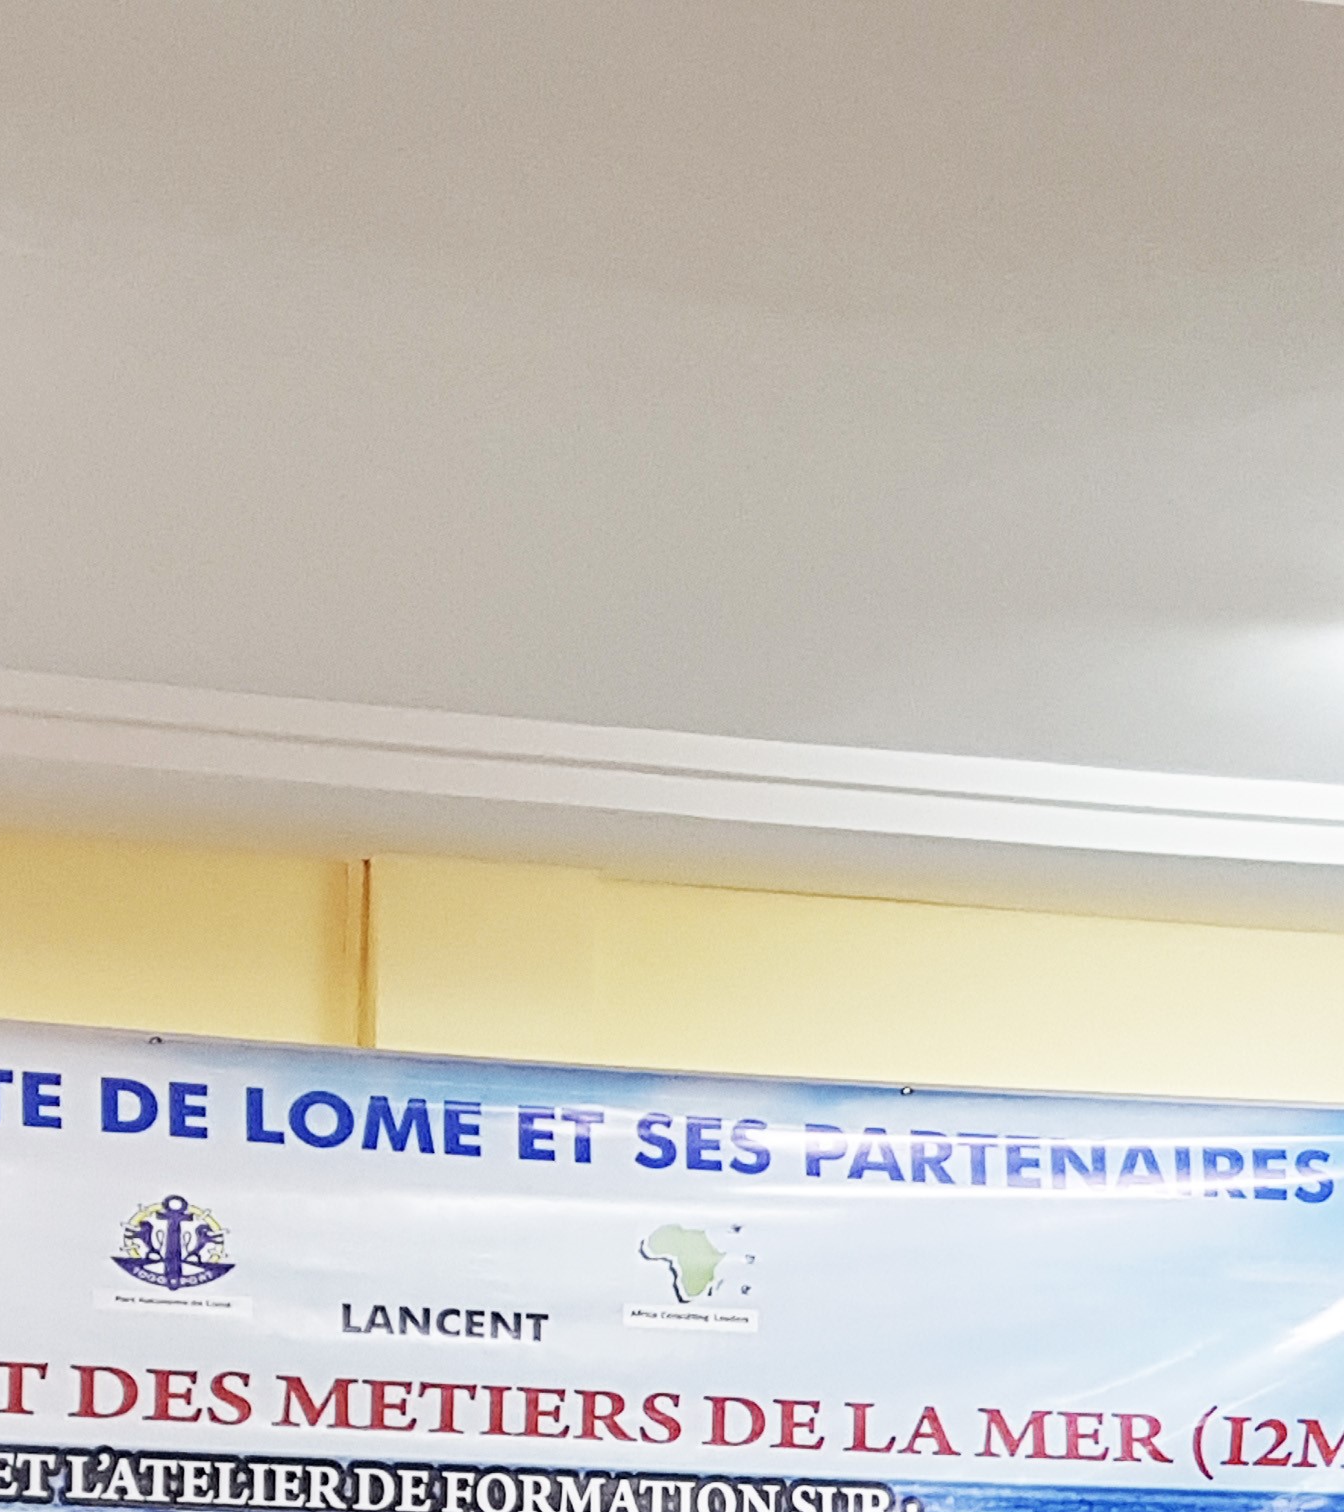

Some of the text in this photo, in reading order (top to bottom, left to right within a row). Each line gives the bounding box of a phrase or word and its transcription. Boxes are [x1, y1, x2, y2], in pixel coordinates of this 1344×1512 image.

[100, 1076, 208, 1140] DE
[246, 1086, 482, 1158] LOME
[518, 1104, 605, 1166] ET
[634, 1111, 772, 1175] SES
[804, 1122, 1335, 1204] PARTENAIRES
[341, 1302, 549, 1343] LANCENT
[69, 1364, 253, 1426] DES
[273, 1374, 682, 1448] METIERS
[702, 1396, 825, 1452] DE
[844, 1401, 962, 1457] LA
[974, 1408, 1172, 1464] MER
[66, 1452, 356, 1510] L'ATELIER
